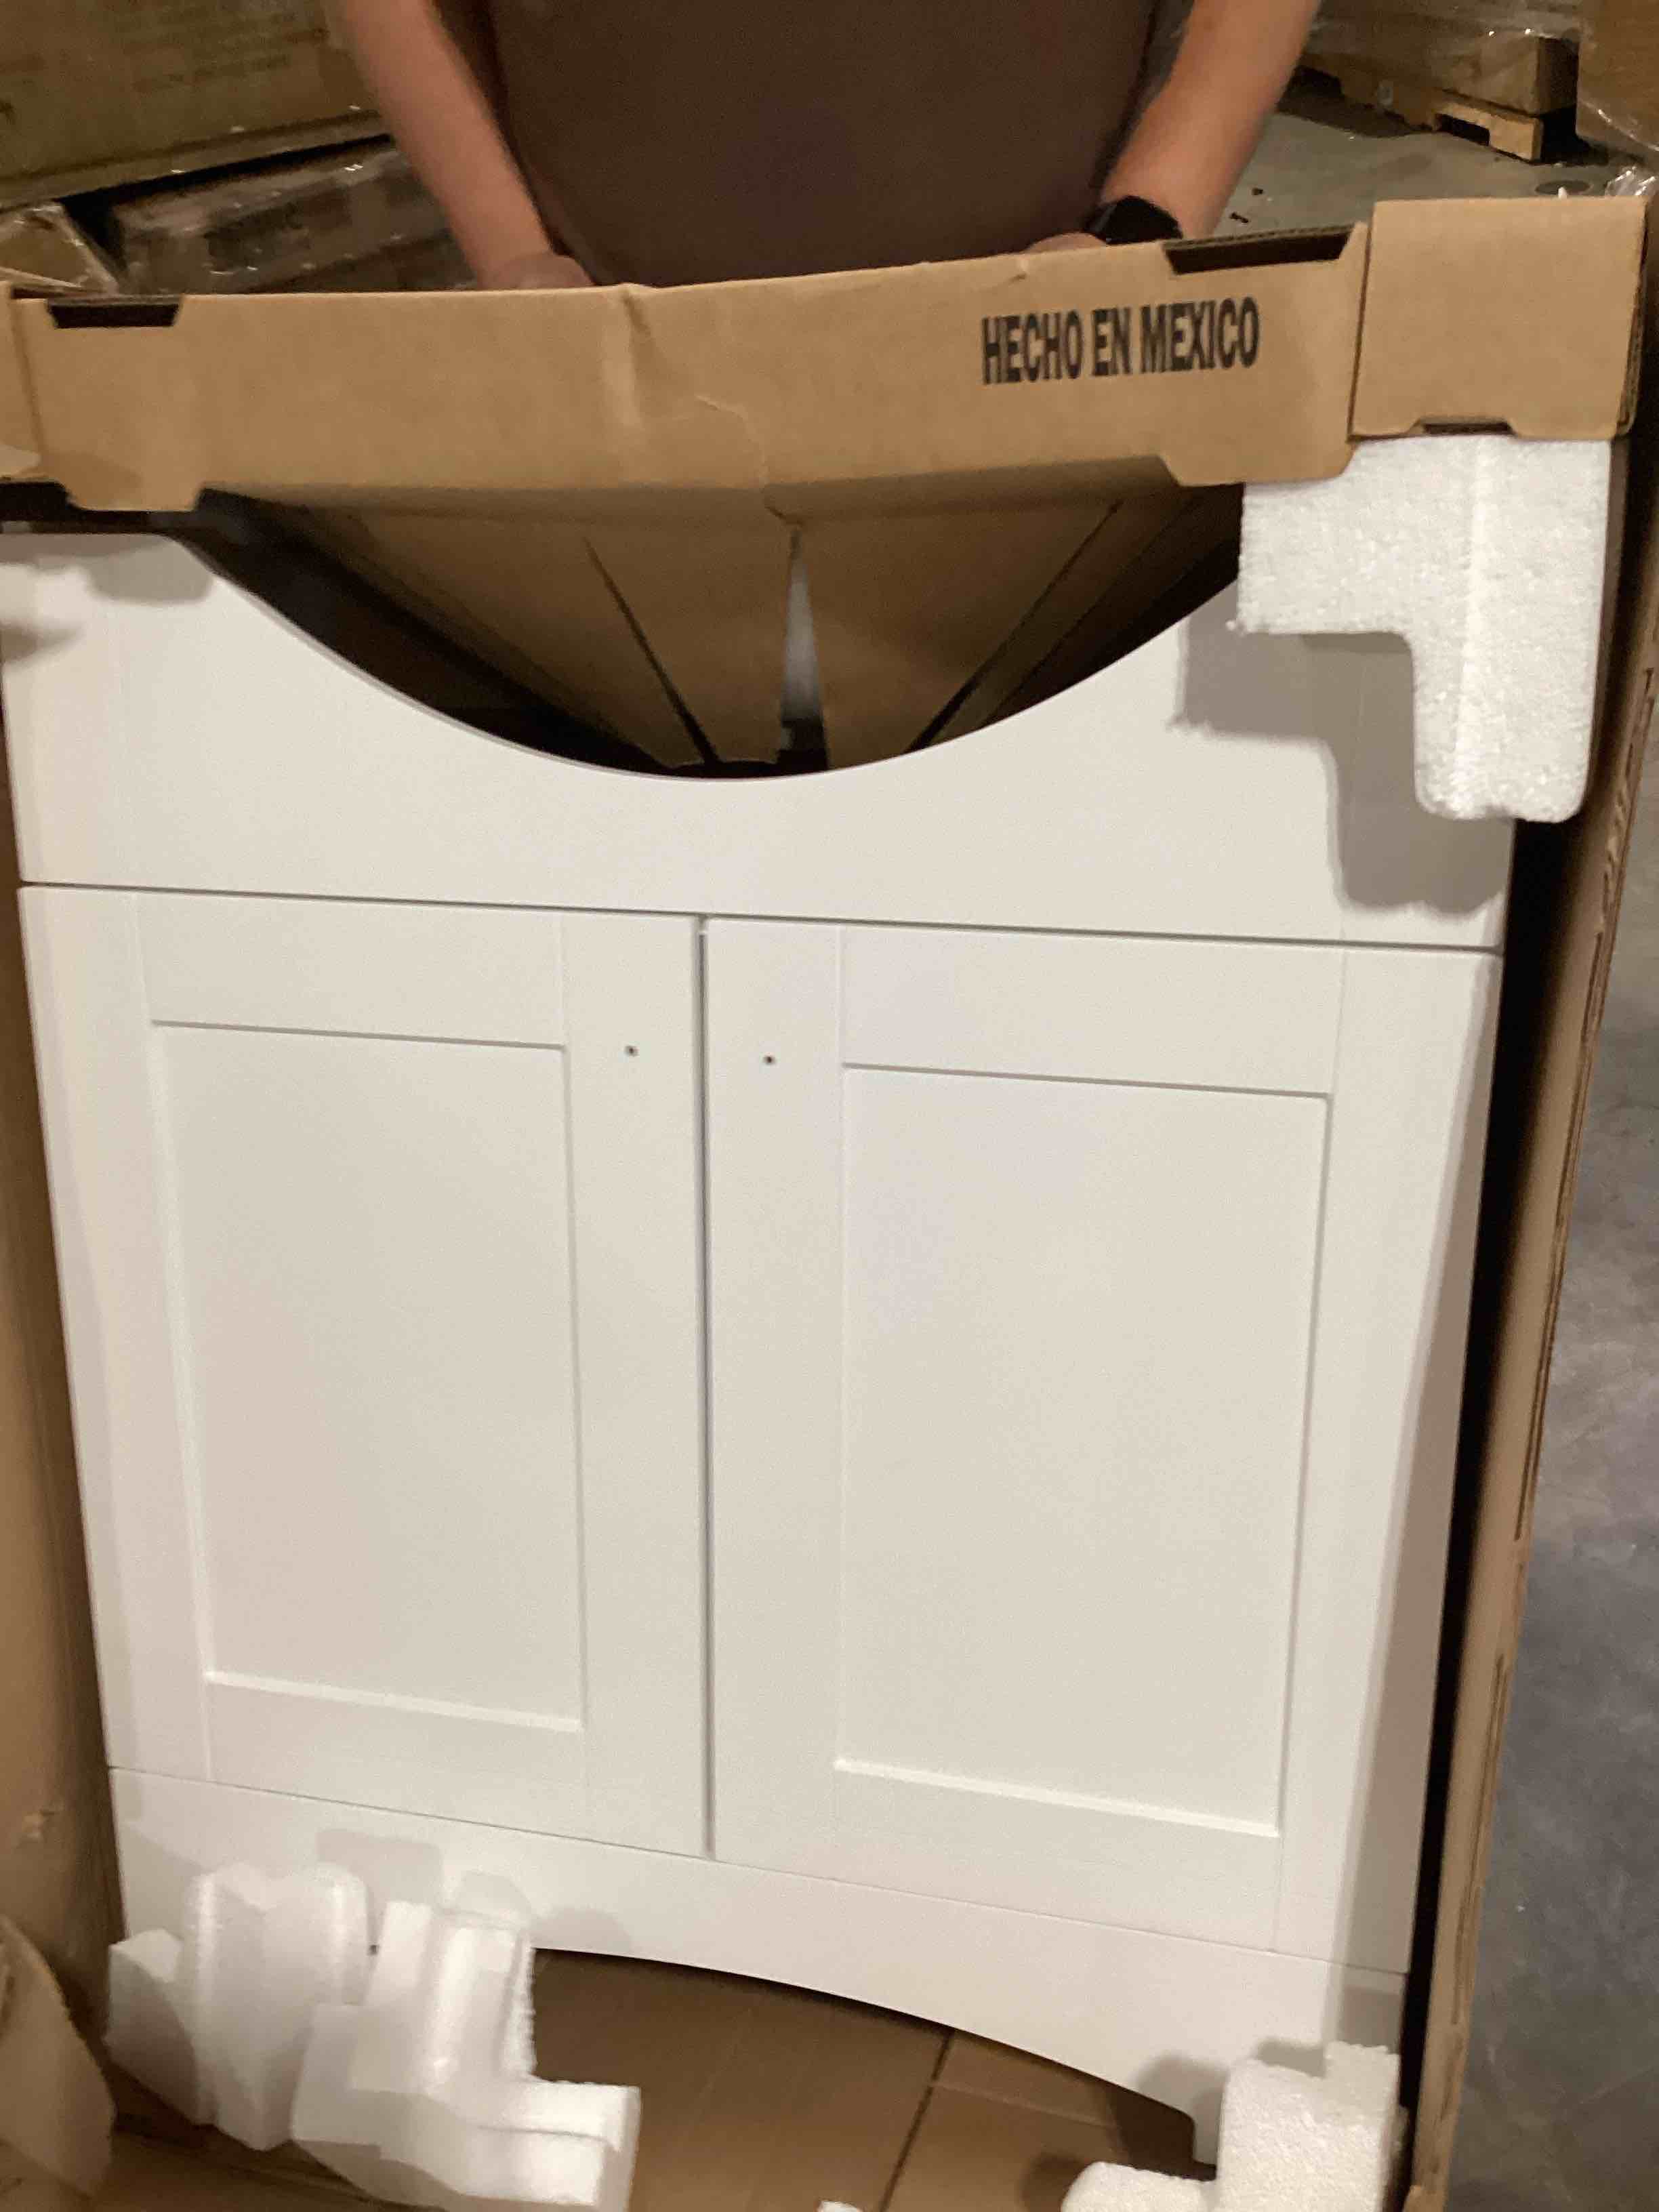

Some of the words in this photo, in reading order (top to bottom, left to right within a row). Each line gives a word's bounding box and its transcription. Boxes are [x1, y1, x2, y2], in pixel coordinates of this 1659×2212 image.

[982, 310, 1084, 384] HECHO
[1092, 307, 1132, 376] EN
[1140, 297, 1259, 373] MEXICO
